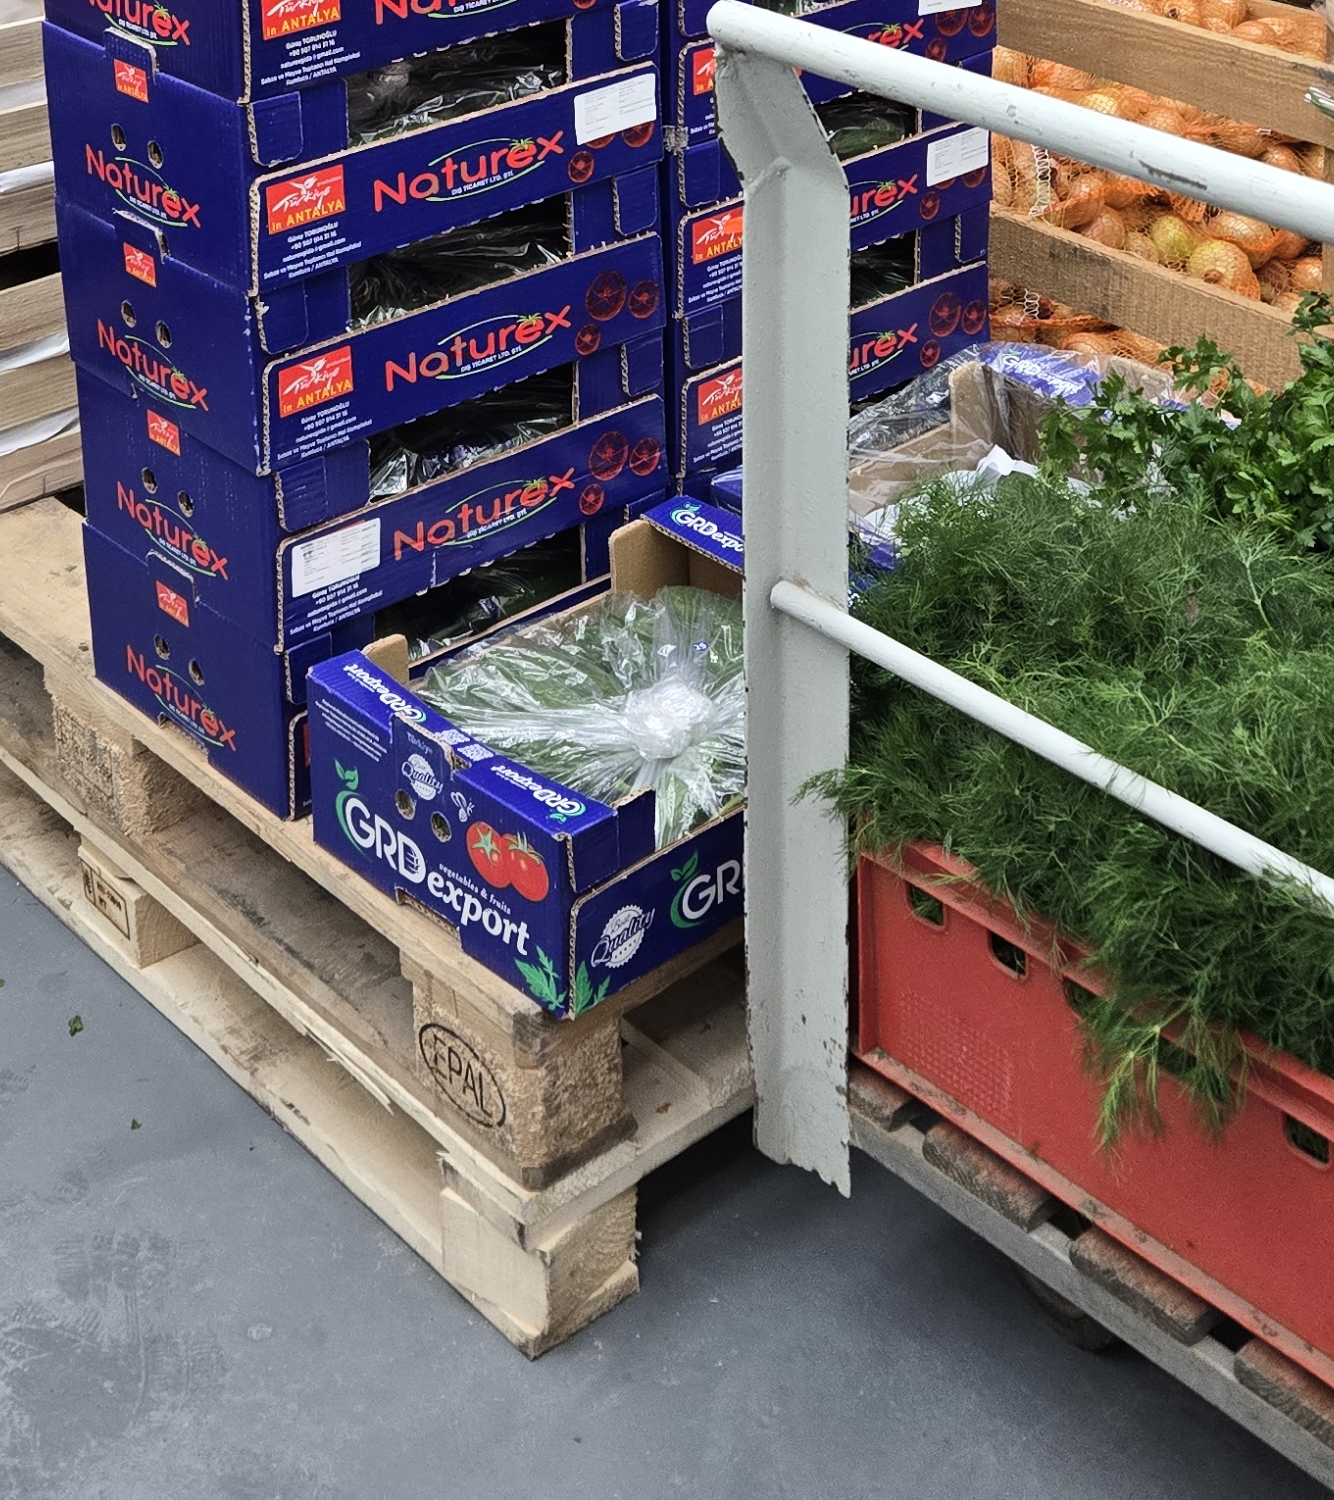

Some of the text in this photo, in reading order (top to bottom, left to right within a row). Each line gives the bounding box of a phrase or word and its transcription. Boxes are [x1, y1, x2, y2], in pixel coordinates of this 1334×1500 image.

[266, 6, 339, 36] in ANTALYA
[86, 147, 200, 226] Naturex
[374, 132, 563, 211] Naturex
[851, 175, 917, 215] urex
[272, 199, 344, 230] in ANTALYA
[707, 236, 742, 255] ANTALY
[98, 321, 207, 411] Naturex
[386, 306, 570, 391] Naturex
[851, 325, 917, 367] urex
[283, 380, 352, 414] in ANTALYA
[711, 399, 742, 416] ANTAL
[118, 484, 227, 577] Naturex
[394, 469, 574, 558] Naturex
[127, 648, 235, 750] Naturex
[401, 761, 444, 796] Quality
[439, 863, 479, 894] vegetables
[490, 893, 512, 915] fruits
[591, 908, 656, 968] Quality
[431, 1033, 493, 1118] EPAL
